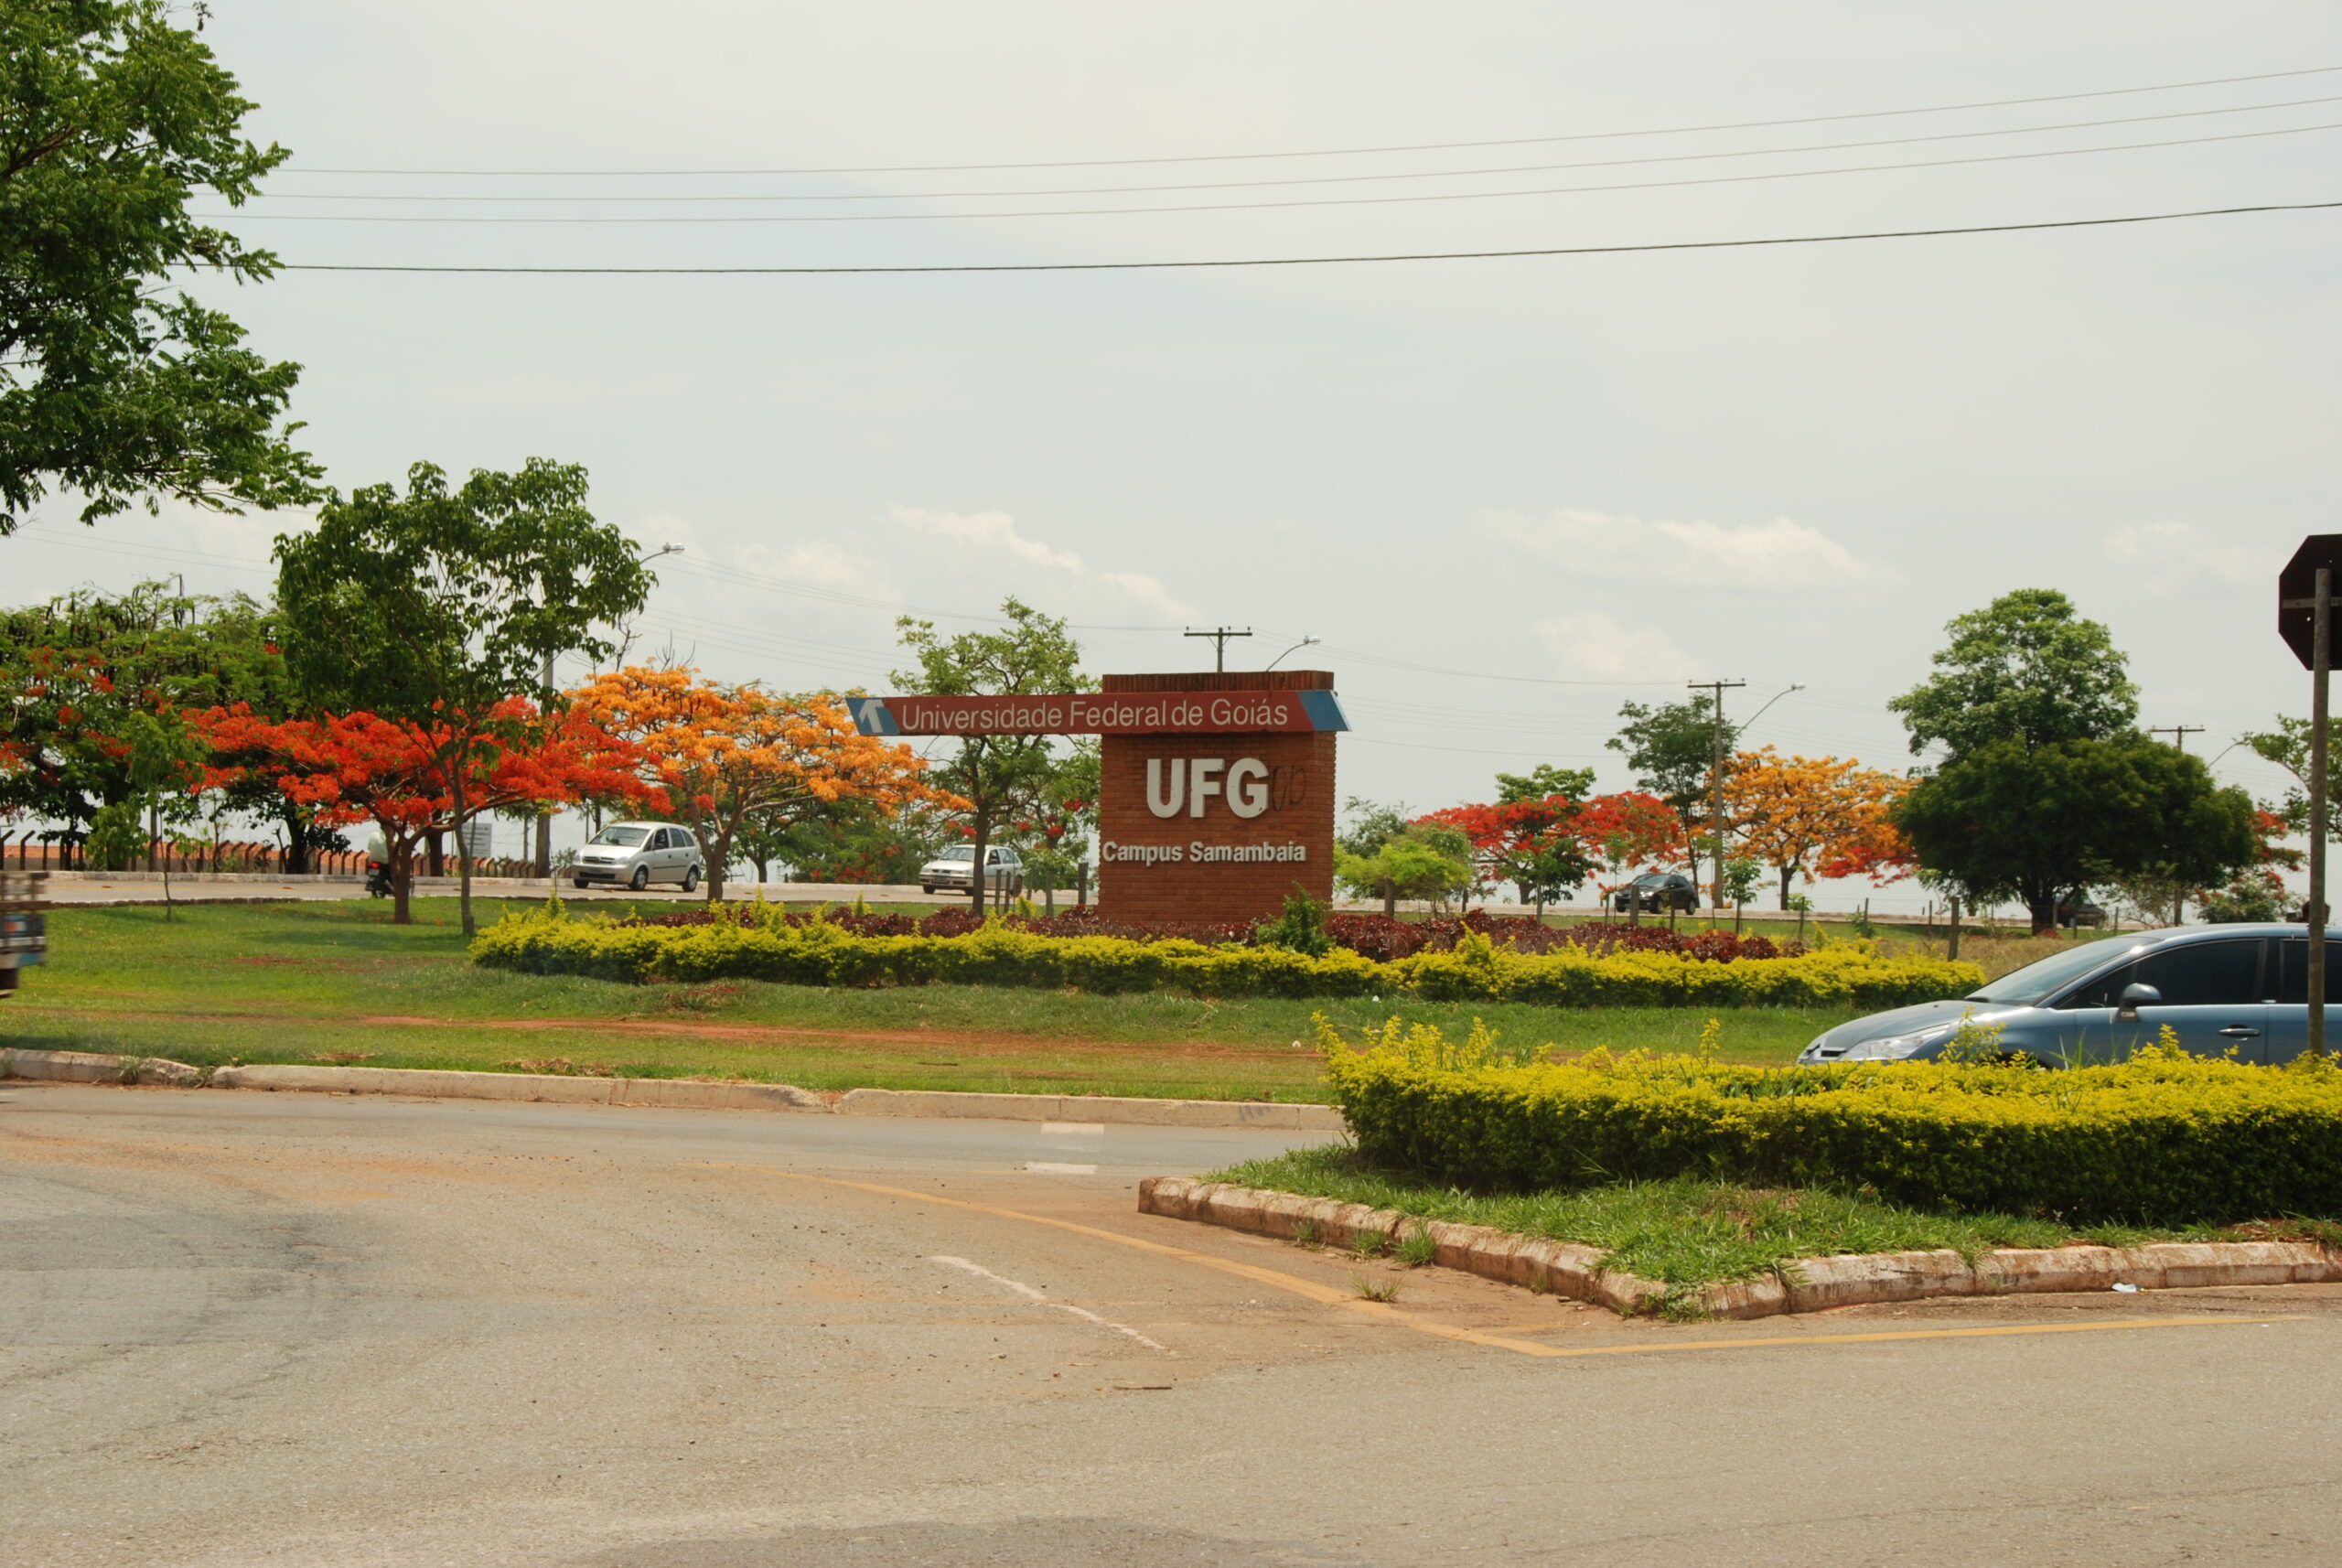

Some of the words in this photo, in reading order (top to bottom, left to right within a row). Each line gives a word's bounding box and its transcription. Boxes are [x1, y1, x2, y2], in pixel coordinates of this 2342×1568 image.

[902, 702, 1062, 731] Universidade
[1069, 700, 1166, 727] Federal
[1171, 700, 1203, 726] de
[1211, 698, 1288, 725] Goiás
[1146, 757, 1270, 819] UFG
[1102, 842, 1183, 866] Campus
[1190, 840, 1306, 863] Samambaia
